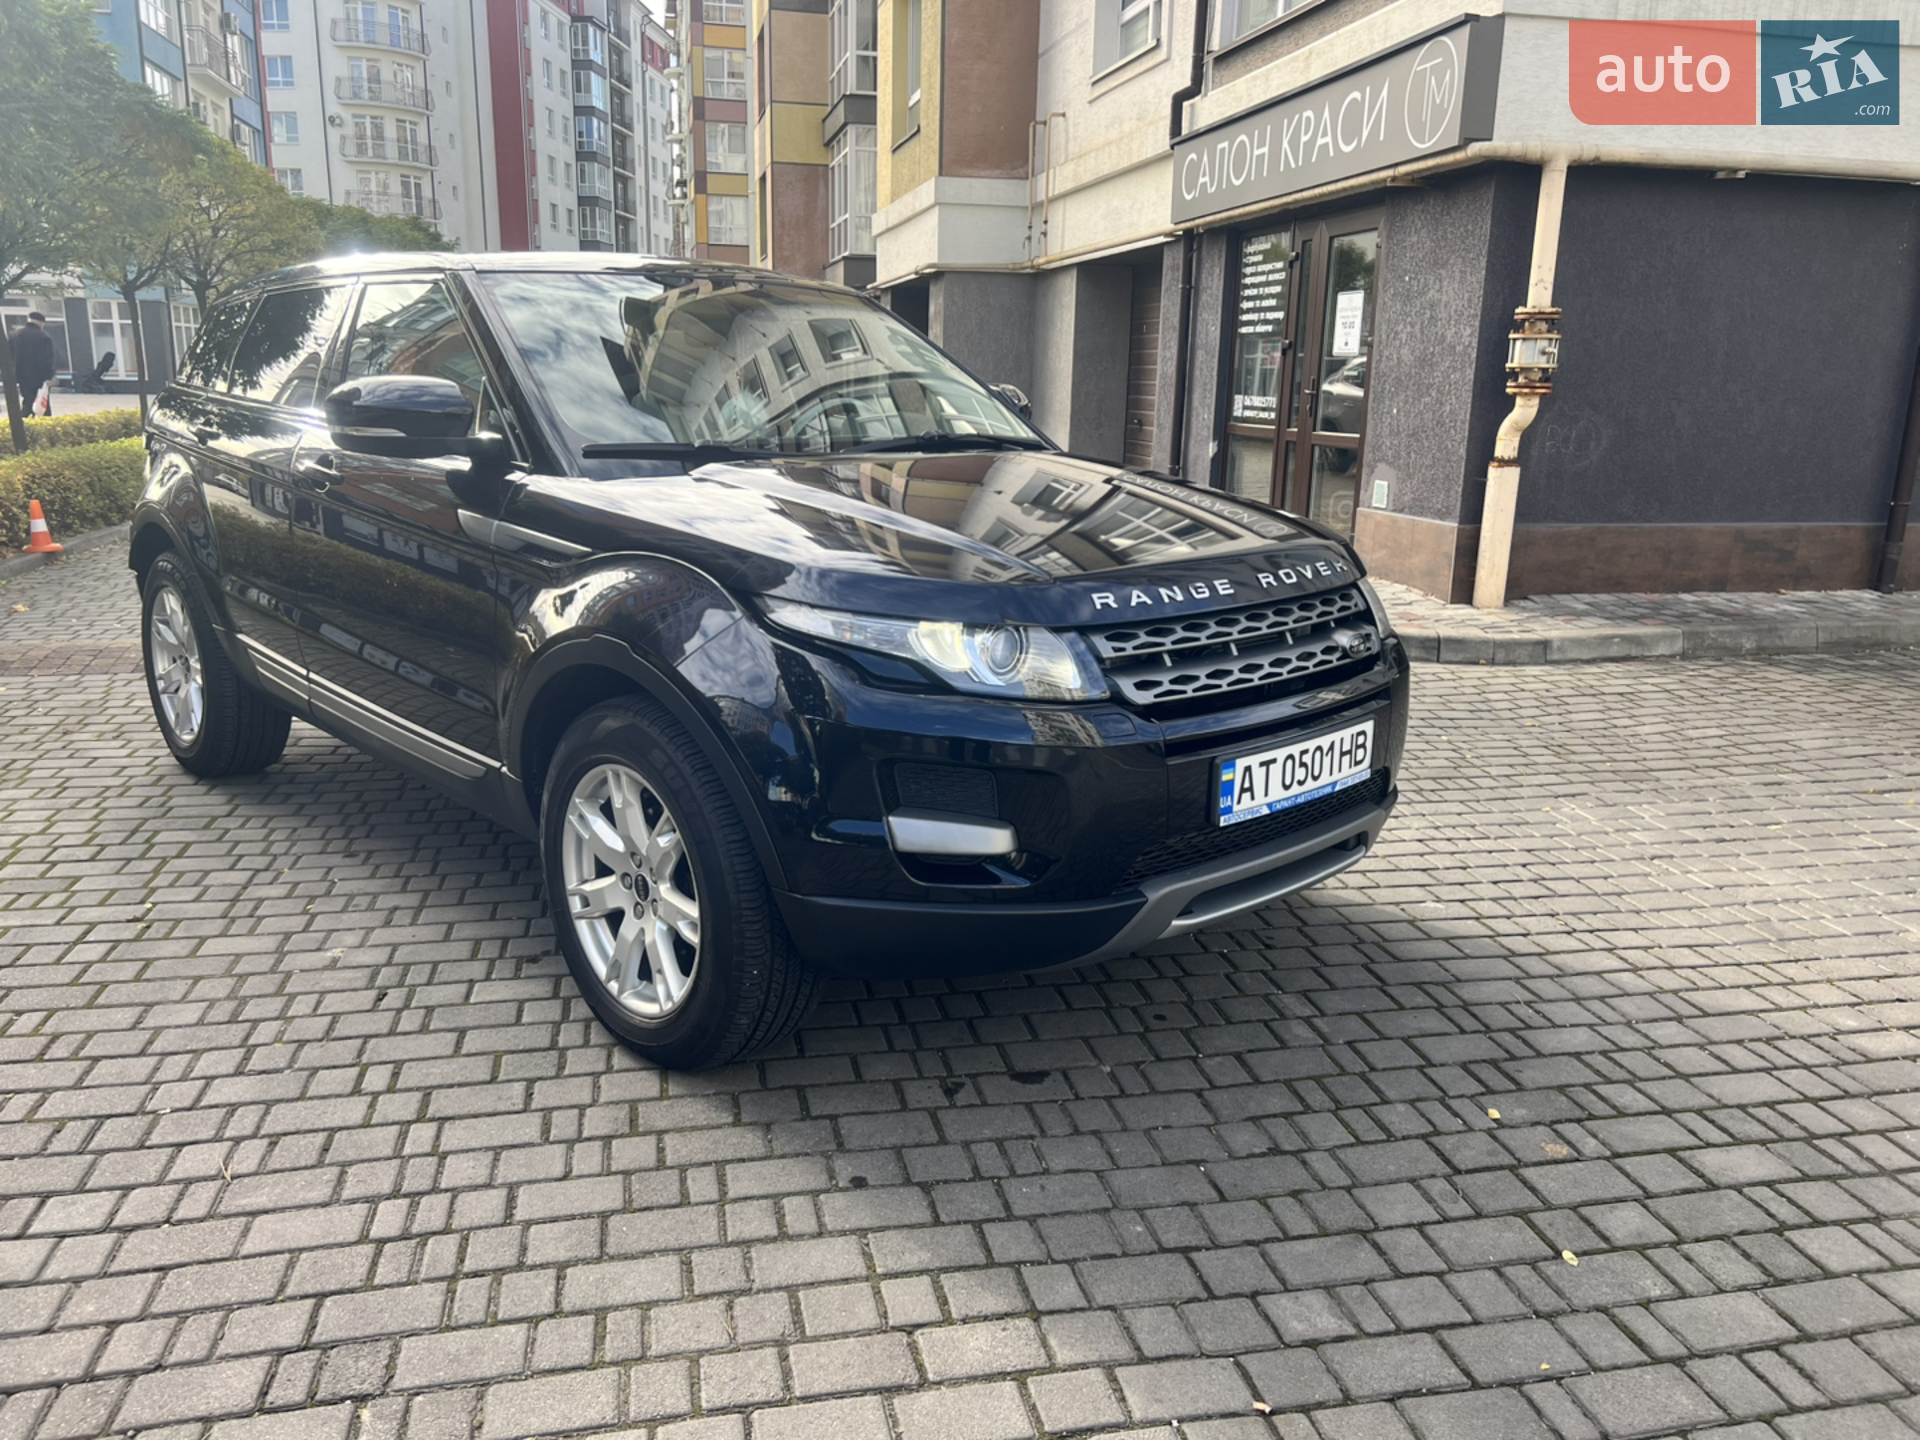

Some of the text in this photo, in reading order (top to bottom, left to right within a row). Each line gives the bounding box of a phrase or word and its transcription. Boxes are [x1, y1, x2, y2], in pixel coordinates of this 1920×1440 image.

[1181, 76, 1390, 201] САЛОН КРАСИ
[1091, 560, 1348, 610] RANGE ROVER
[1220, 794, 1232, 809] UA
